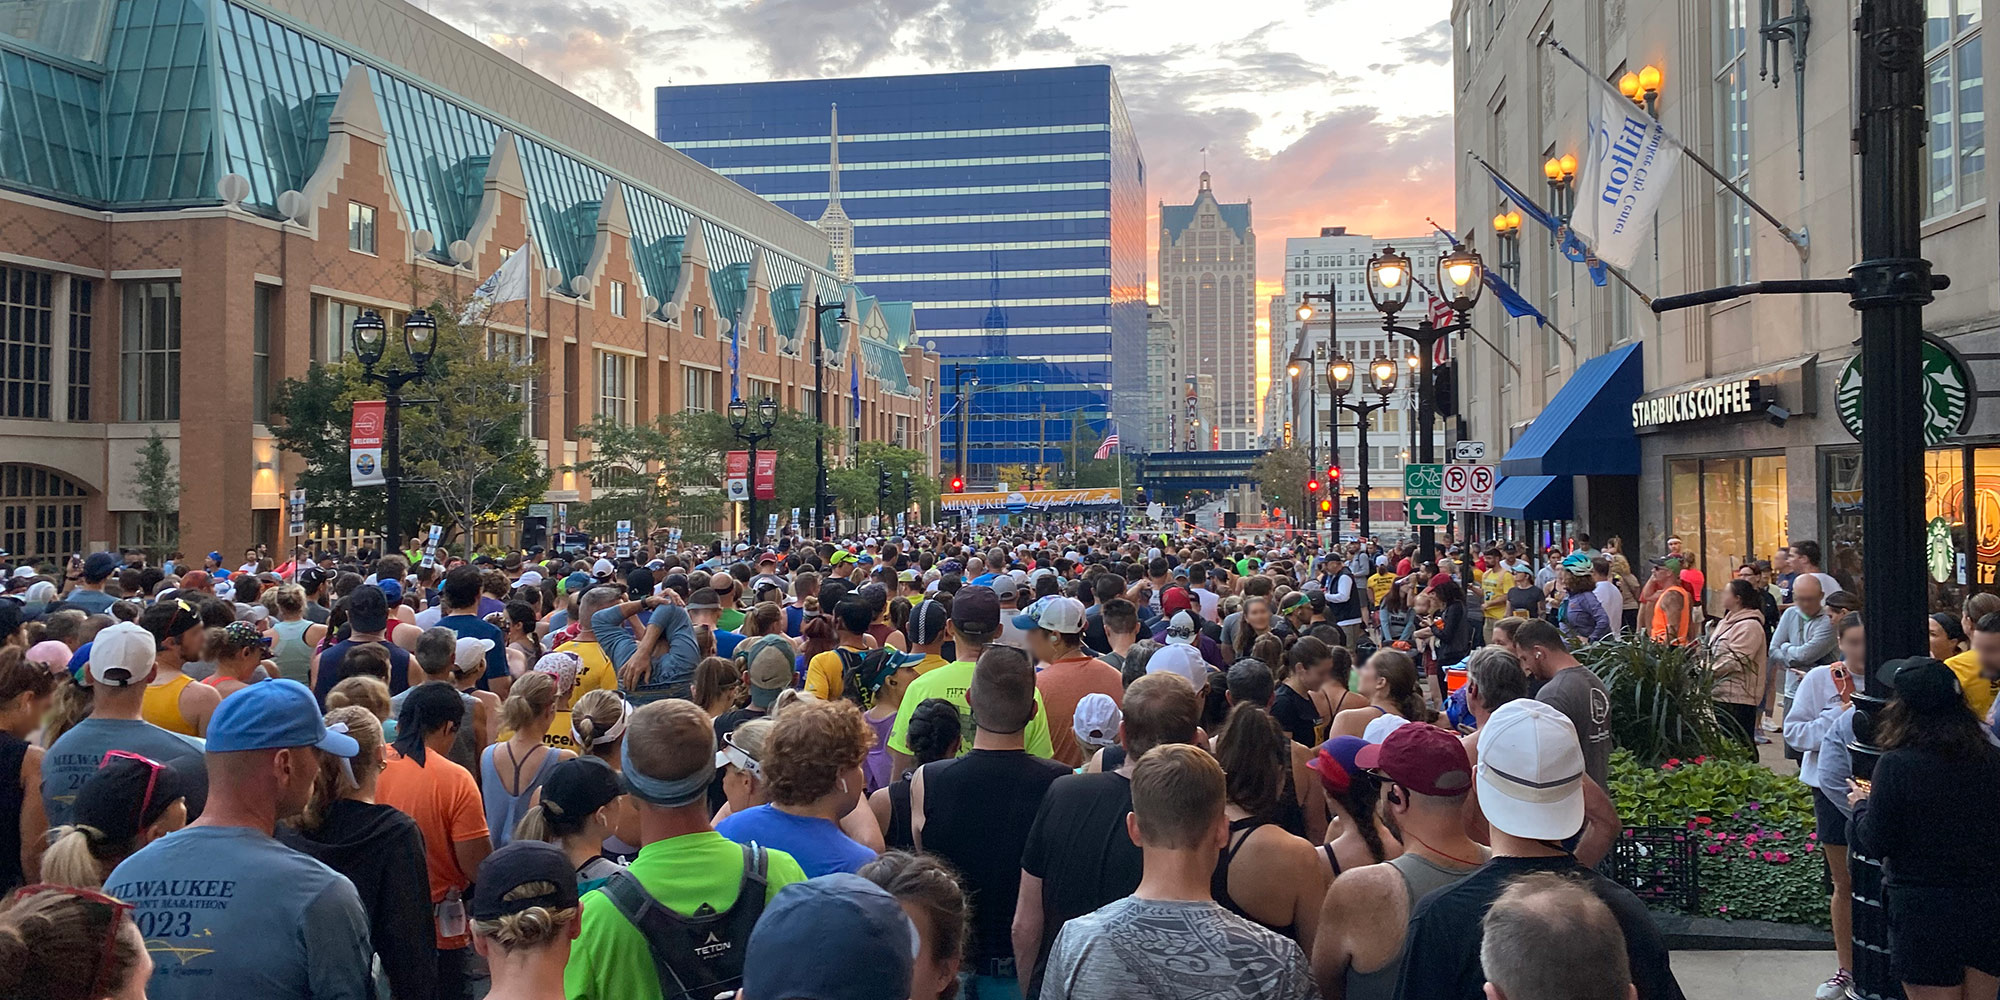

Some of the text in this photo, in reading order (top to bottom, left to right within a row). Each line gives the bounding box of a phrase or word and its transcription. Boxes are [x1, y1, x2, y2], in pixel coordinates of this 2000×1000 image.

[1632, 380, 1752, 428] STARBUCKS COFFEE
[1408, 488, 1442, 496] BIKE ROU
[941, 491, 1120, 512] MILWAUKEE Lakefront Marathon
[161, 899, 228, 910] MARATHON
[131, 911, 192, 938] 023
[694, 942, 731, 956] TETON
